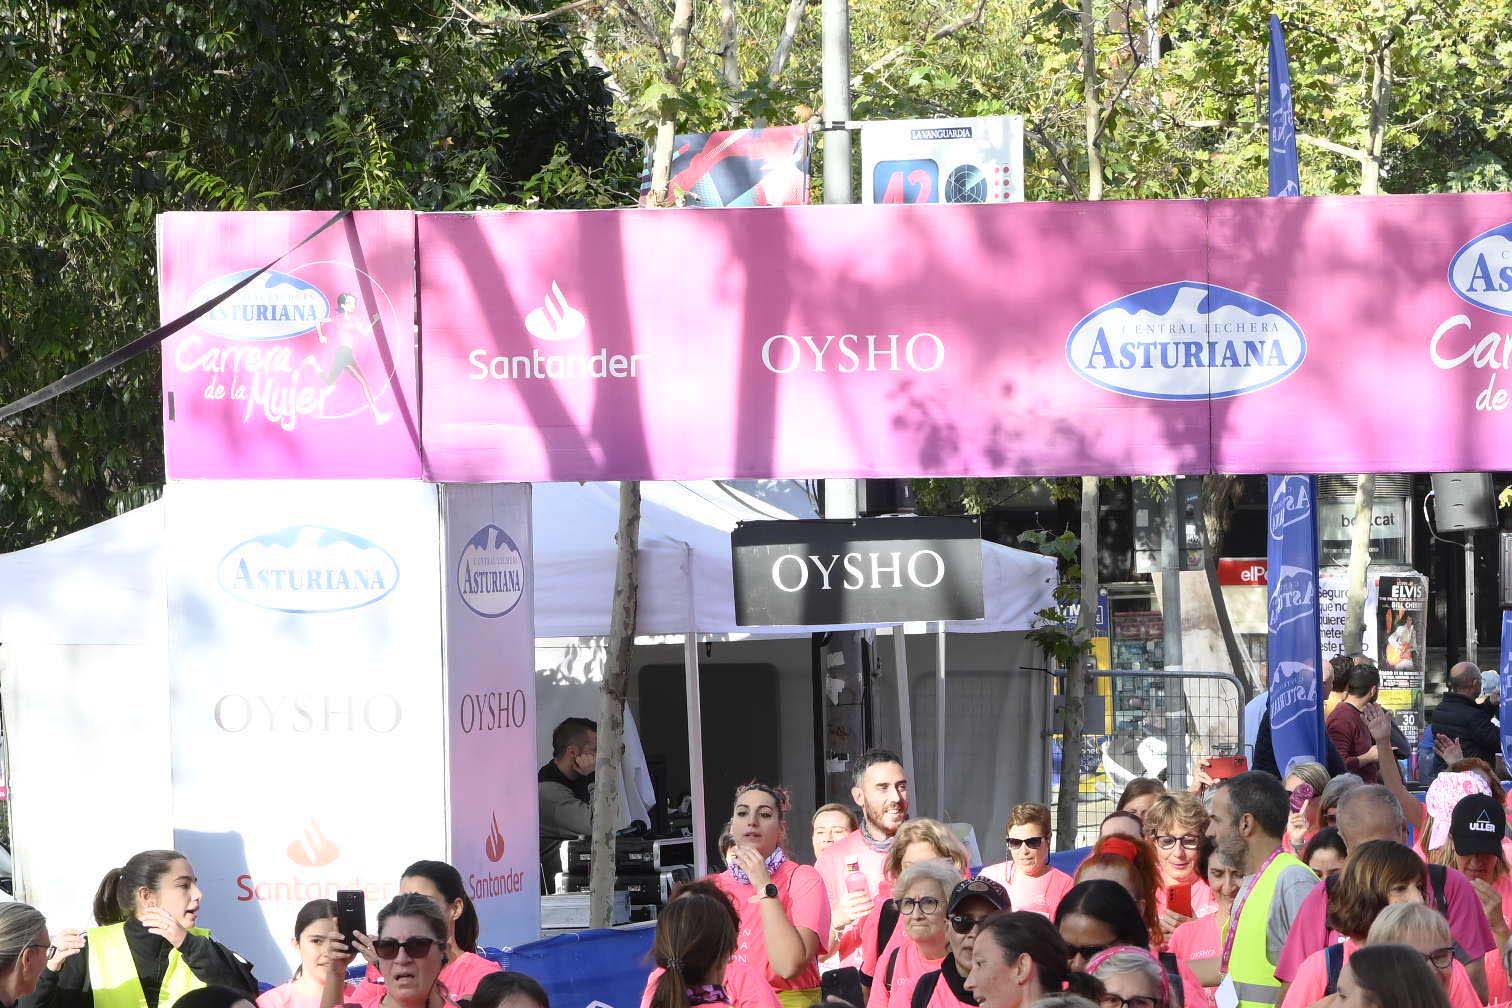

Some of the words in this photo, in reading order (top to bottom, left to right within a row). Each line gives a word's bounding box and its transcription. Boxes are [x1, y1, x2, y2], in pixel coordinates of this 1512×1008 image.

[469, 349, 643, 379] Santander
[761, 332, 945, 374] OYSHO
[1084, 326, 1288, 369] ASTURIANA
[1476, 372, 1509, 411] de
[233, 558, 386, 592] ASTURIANA
[462, 562, 521, 595] ASTURIANA
[771, 550, 945, 592] OYSHO
[1392, 586, 1424, 598] ELVIS
[214, 693, 402, 735] OYSHO
[460, 689, 526, 734] OYSHO
[1469, 822, 1496, 833] ULLER
[469, 869, 525, 901] Santander
